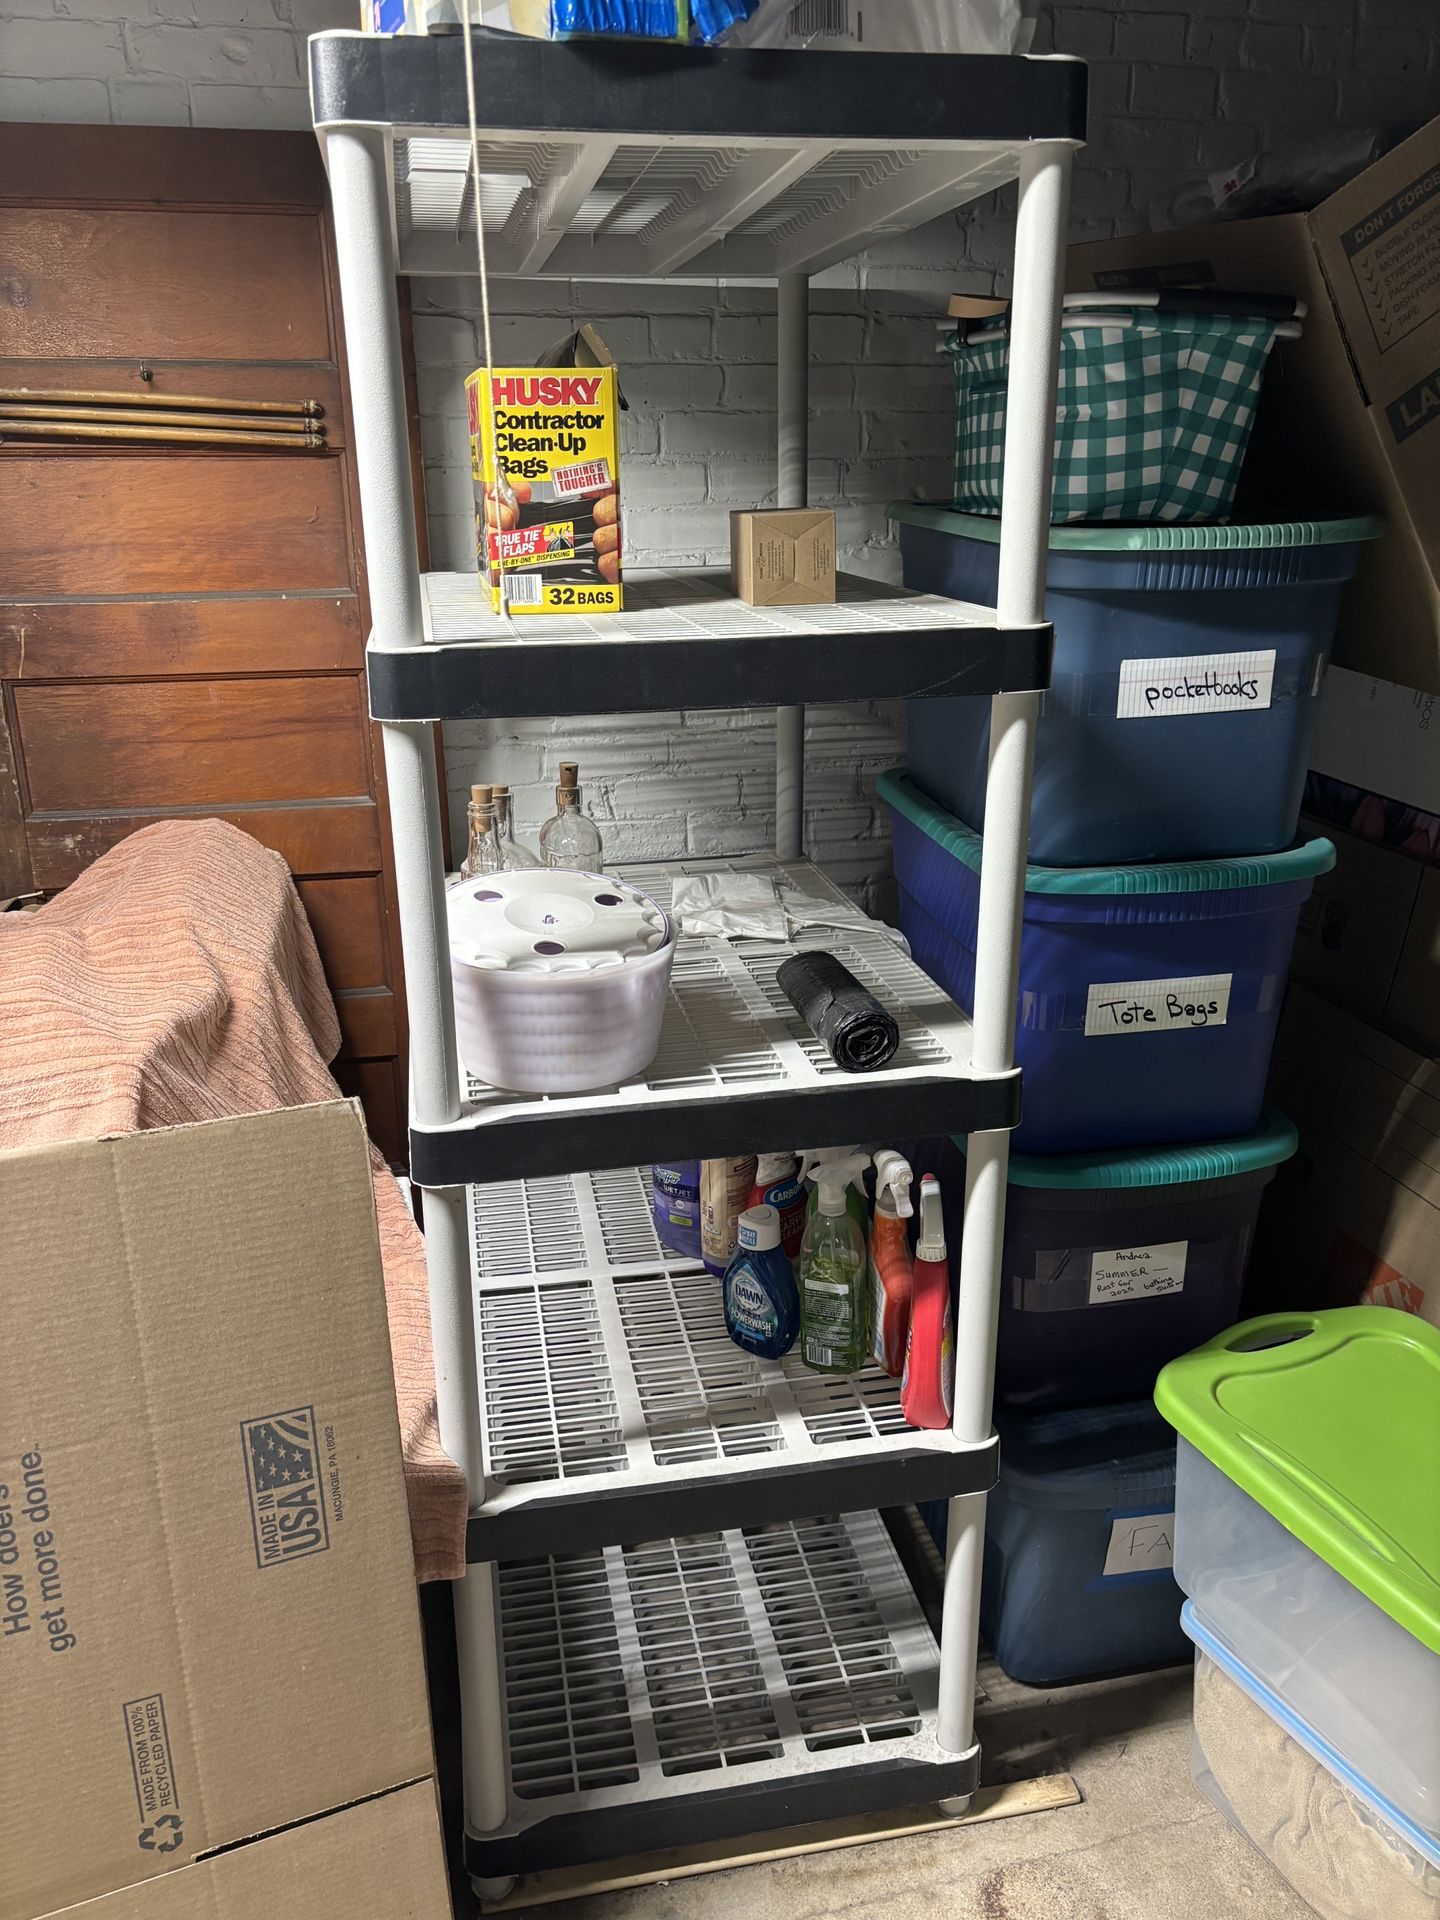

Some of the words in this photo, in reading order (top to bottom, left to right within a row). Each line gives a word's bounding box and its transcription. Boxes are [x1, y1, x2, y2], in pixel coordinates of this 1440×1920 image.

[1354, 208, 1395, 244] DON'T
[1379, 243, 1415, 272] MOVING
[1384, 254, 1425, 287] STRETCH
[1388, 266, 1428, 300] PACKING
[1398, 305, 1420, 326] TAPE
[492, 377, 603, 406] HUSKY
[494, 410, 605, 430] Contractor
[495, 433, 586, 455] Clean-Up
[498, 456, 549, 478] Bags
[556, 463, 603, 480] NOTHING'S
[558, 473, 606, 492] TOUGHER
[495, 532, 520, 546] TRUE
[523, 529, 540, 544] TIE
[503, 542, 535, 557] FLAPS
[536, 550, 570, 562] DISPENSING
[550, 588, 575, 605] 32
[577, 591, 614, 604] BAGS
[1145, 670, 1258, 710] pocketbooks
[1099, 1000, 1156, 1026] Tote
[1166, 994, 1218, 1026] Bags
[1095, 1266, 1149, 1281] SUMMER
[735, 1283, 763, 1304] DAWN
[731, 1306, 771, 1331] POWERWASH
[323, 1425, 336, 1453] 18062
[328, 1453, 338, 1468] PA
[257, 1493, 275, 1512] IN
[277, 1483, 322, 1554] USA
[259, 1513, 282, 1561] MADE
[32, 1529, 63, 1602] more
[2, 1574, 31, 1636] How
[40, 1606, 77, 1652] get
[131, 1706, 145, 1740] 100%
[145, 1701, 162, 1741] PAPER
[136, 1740, 151, 1775] FROM
[152, 1743, 172, 1807] RECYCLED
[141, 1776, 158, 1813] MADE
